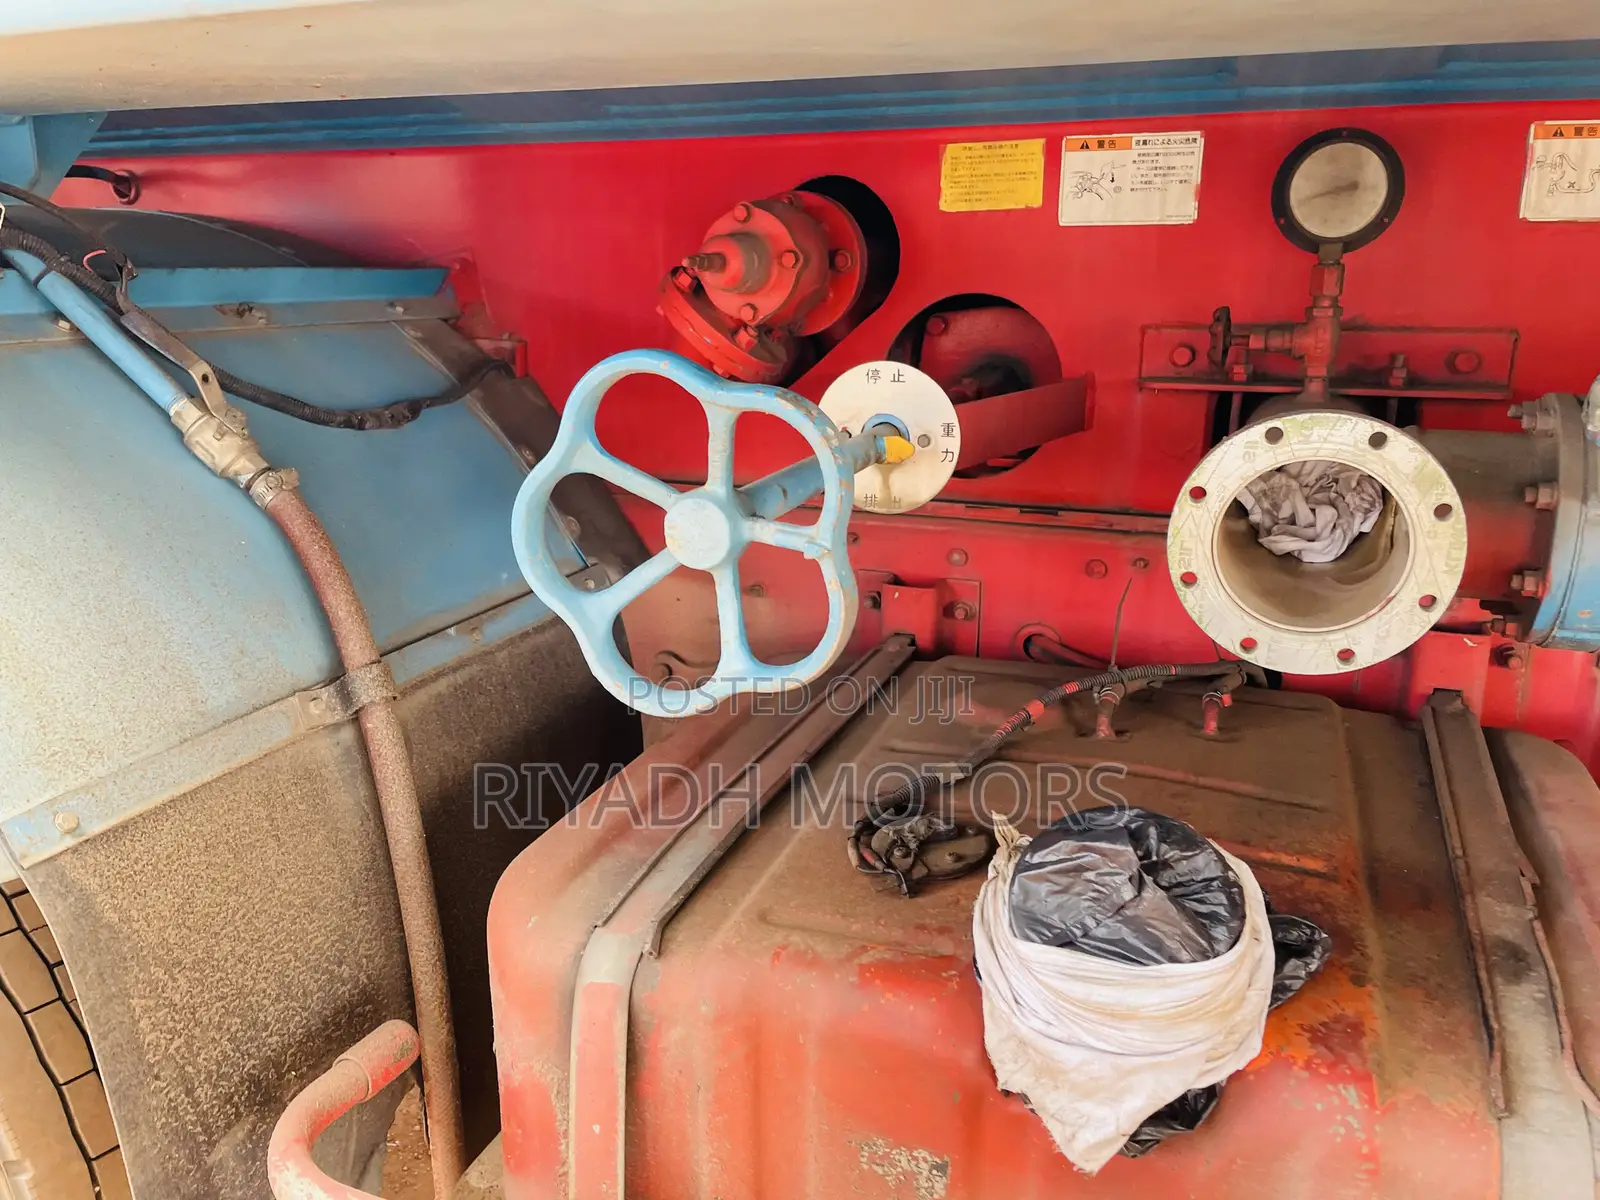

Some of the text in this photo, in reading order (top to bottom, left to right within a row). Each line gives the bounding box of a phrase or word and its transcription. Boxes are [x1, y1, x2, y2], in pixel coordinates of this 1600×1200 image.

[1097, 139, 1117, 149] 警告
[865, 368, 906, 384] 停止
[940, 422, 956, 463] 重力
